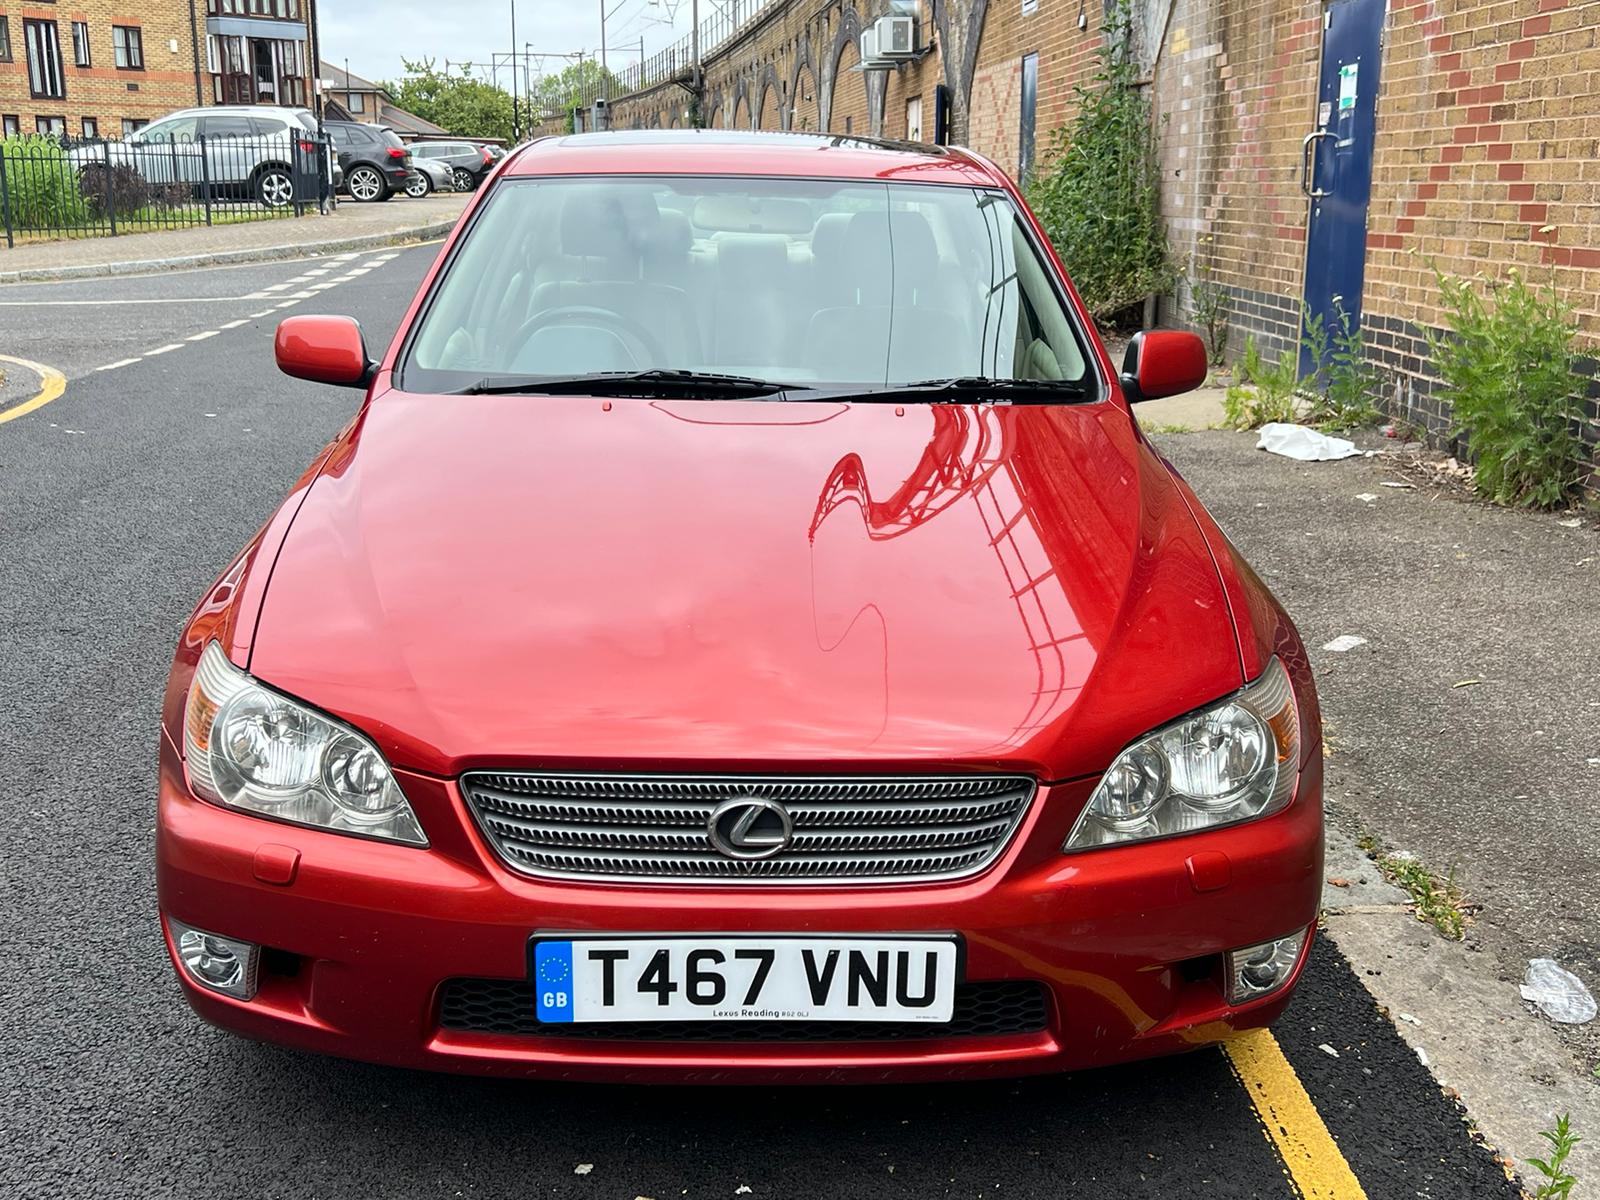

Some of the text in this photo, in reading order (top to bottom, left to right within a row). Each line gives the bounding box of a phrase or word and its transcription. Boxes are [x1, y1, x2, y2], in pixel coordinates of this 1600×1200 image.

[588, 949, 938, 1008] T467 VNU
[543, 991, 568, 1008] GB
[741, 1009, 780, 1018] Reading
